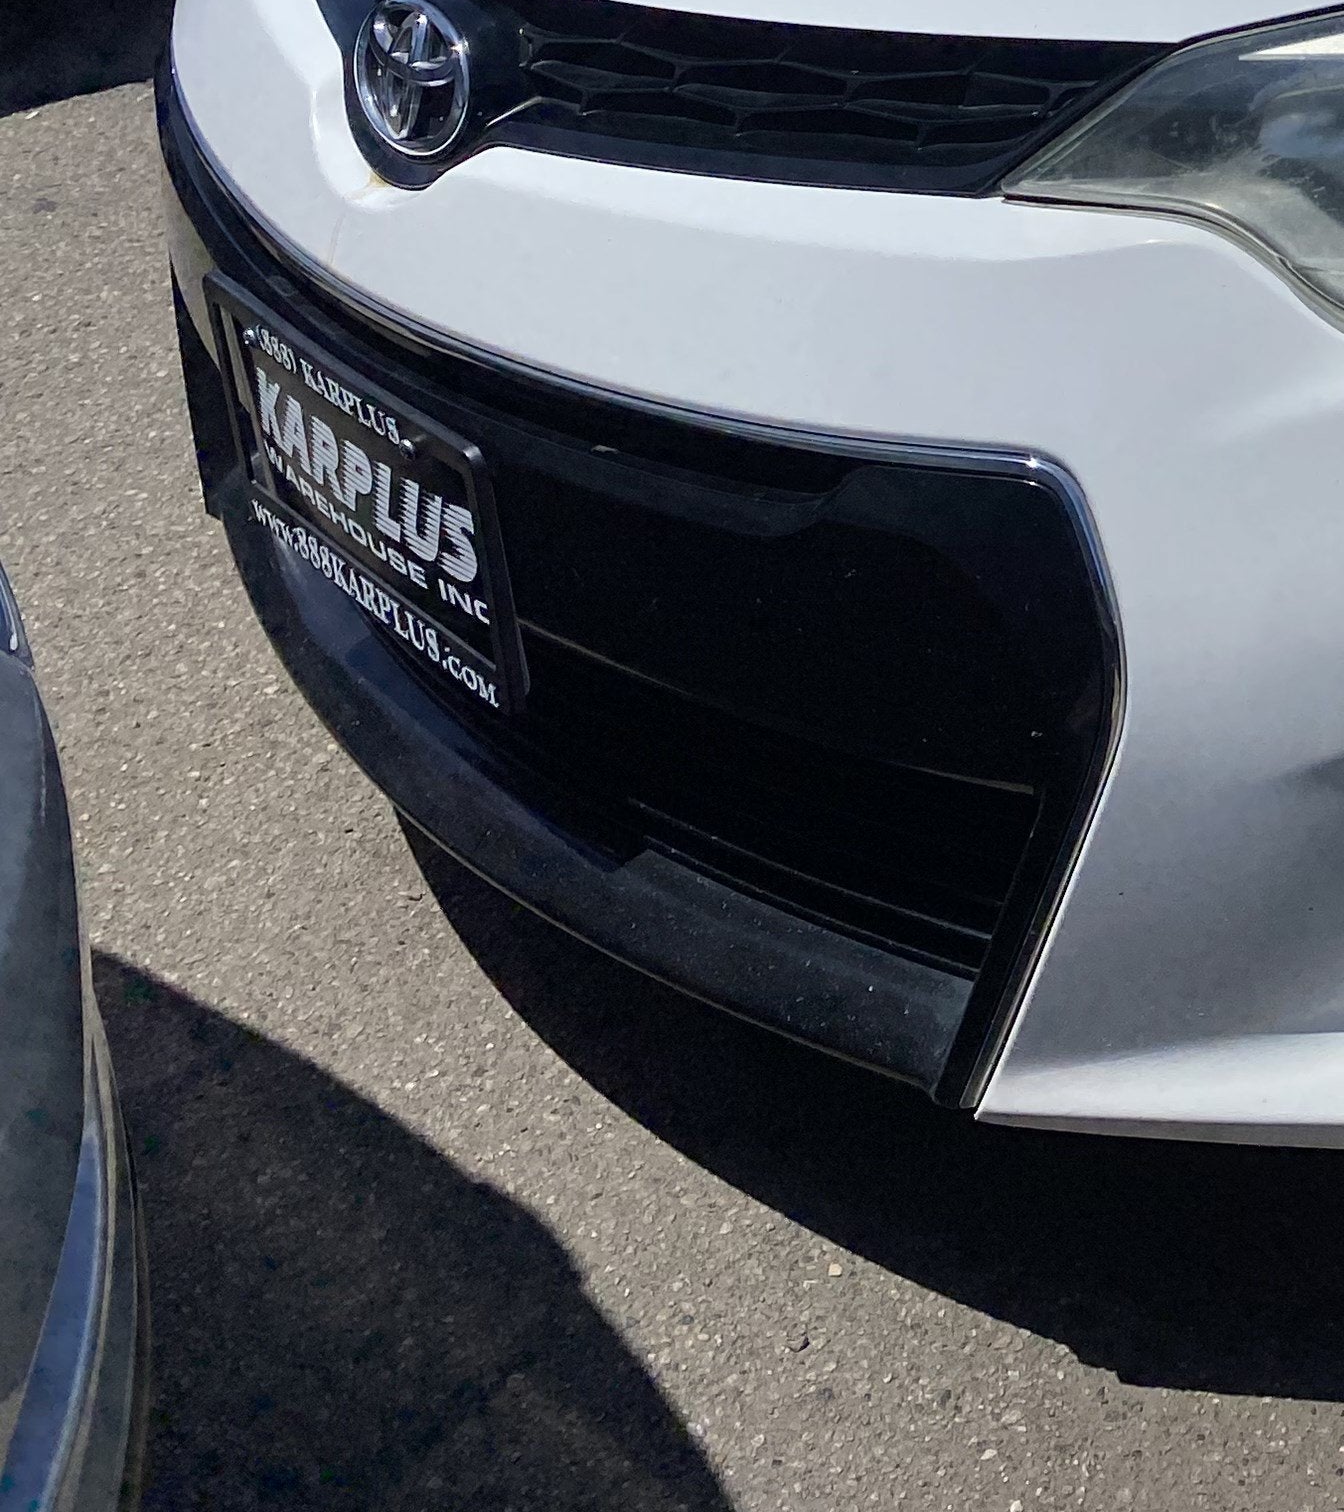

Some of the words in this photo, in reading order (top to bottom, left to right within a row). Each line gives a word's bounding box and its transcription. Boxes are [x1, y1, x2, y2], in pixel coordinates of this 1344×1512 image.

[255, 324, 298, 375] (888)
[299, 358, 400, 445] KARPLUS
[256, 366, 479, 583] KARPLUS
[264, 439, 429, 590] WAREHOUSE
[438, 578, 490, 625] INC
